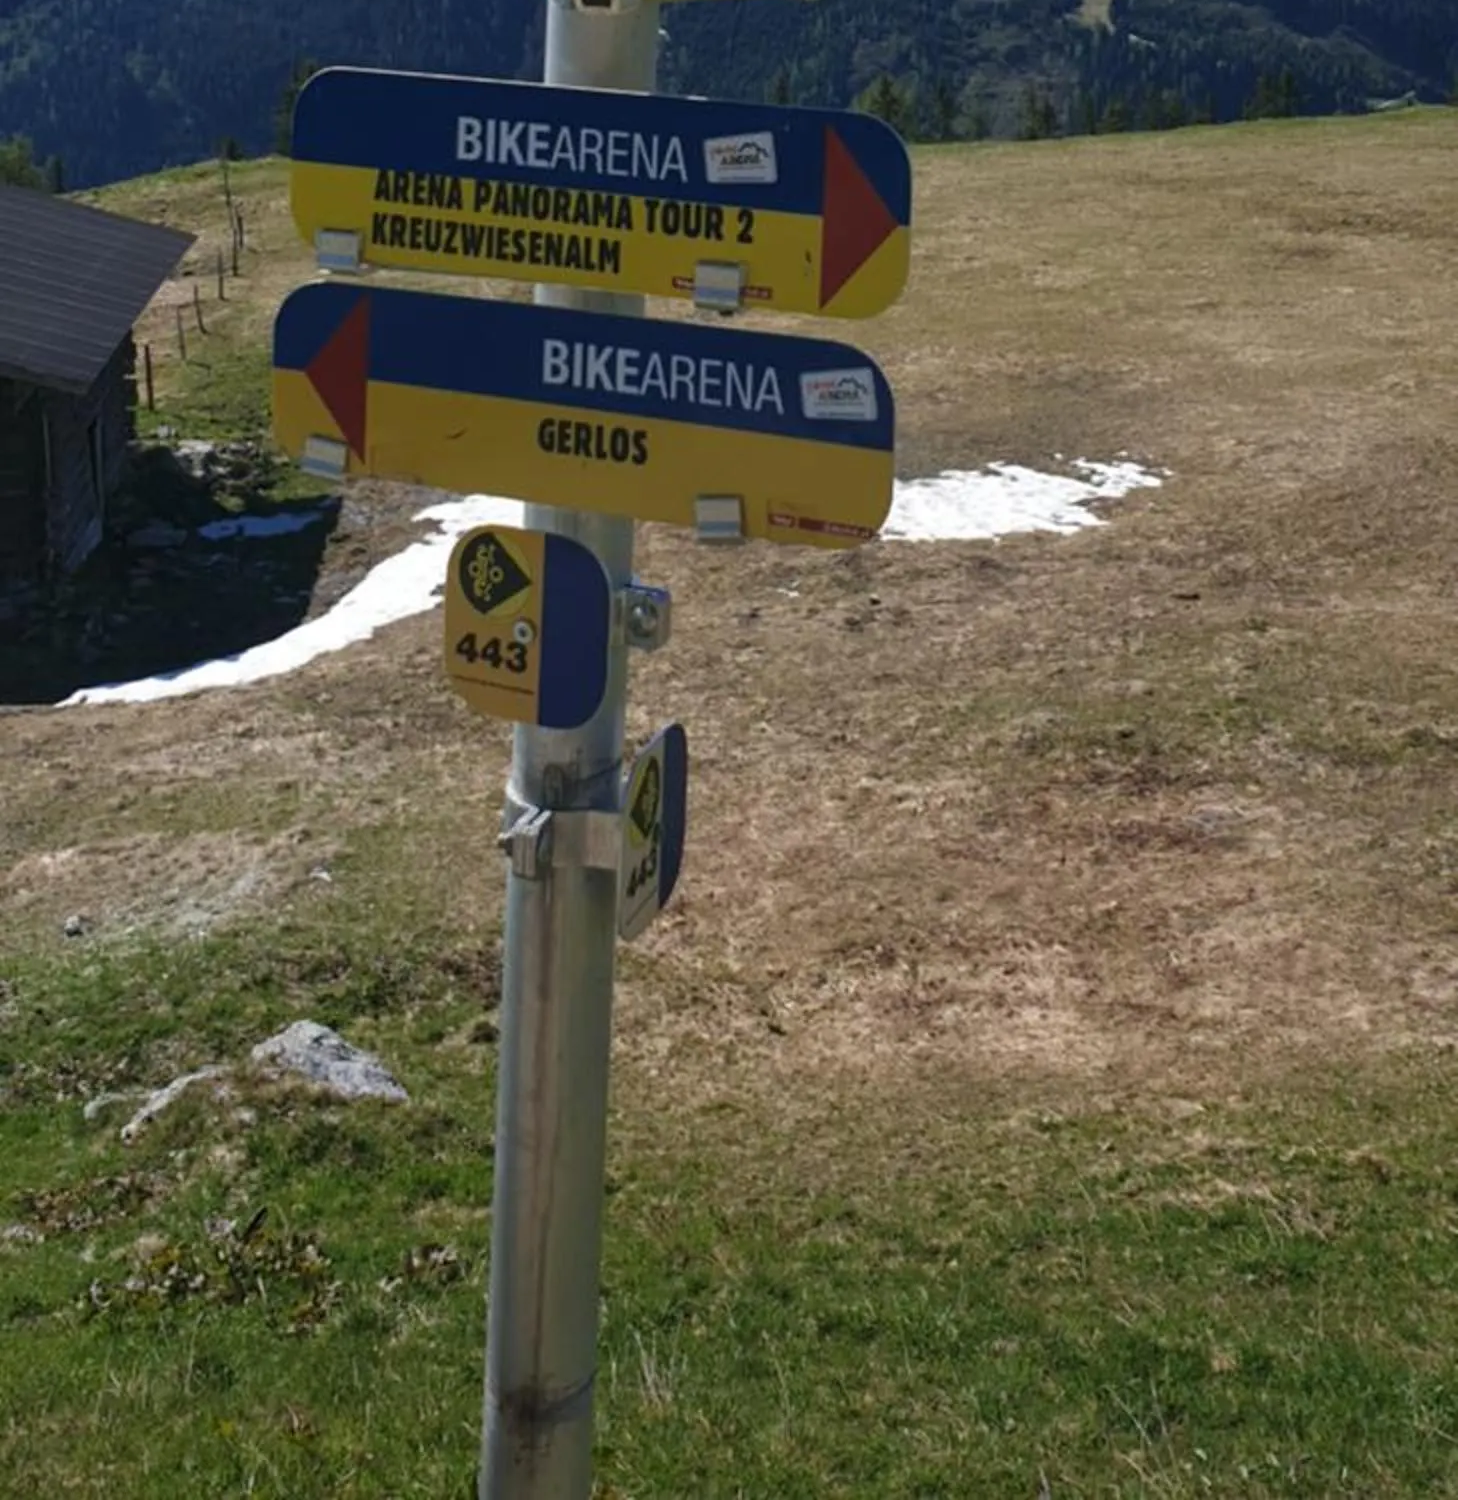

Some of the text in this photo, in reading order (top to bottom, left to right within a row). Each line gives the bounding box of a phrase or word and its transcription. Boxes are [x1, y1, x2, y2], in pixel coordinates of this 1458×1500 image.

[456, 116, 688, 183] BIKEARENA
[374, 169, 754, 243] ARENA PANORAMA TOUR 2
[371, 212, 621, 274] KREUZWIESENALM
[542, 338, 784, 415] BIKEARENA
[537, 418, 648, 465] GERLOS
[456, 633, 527, 673] 443
